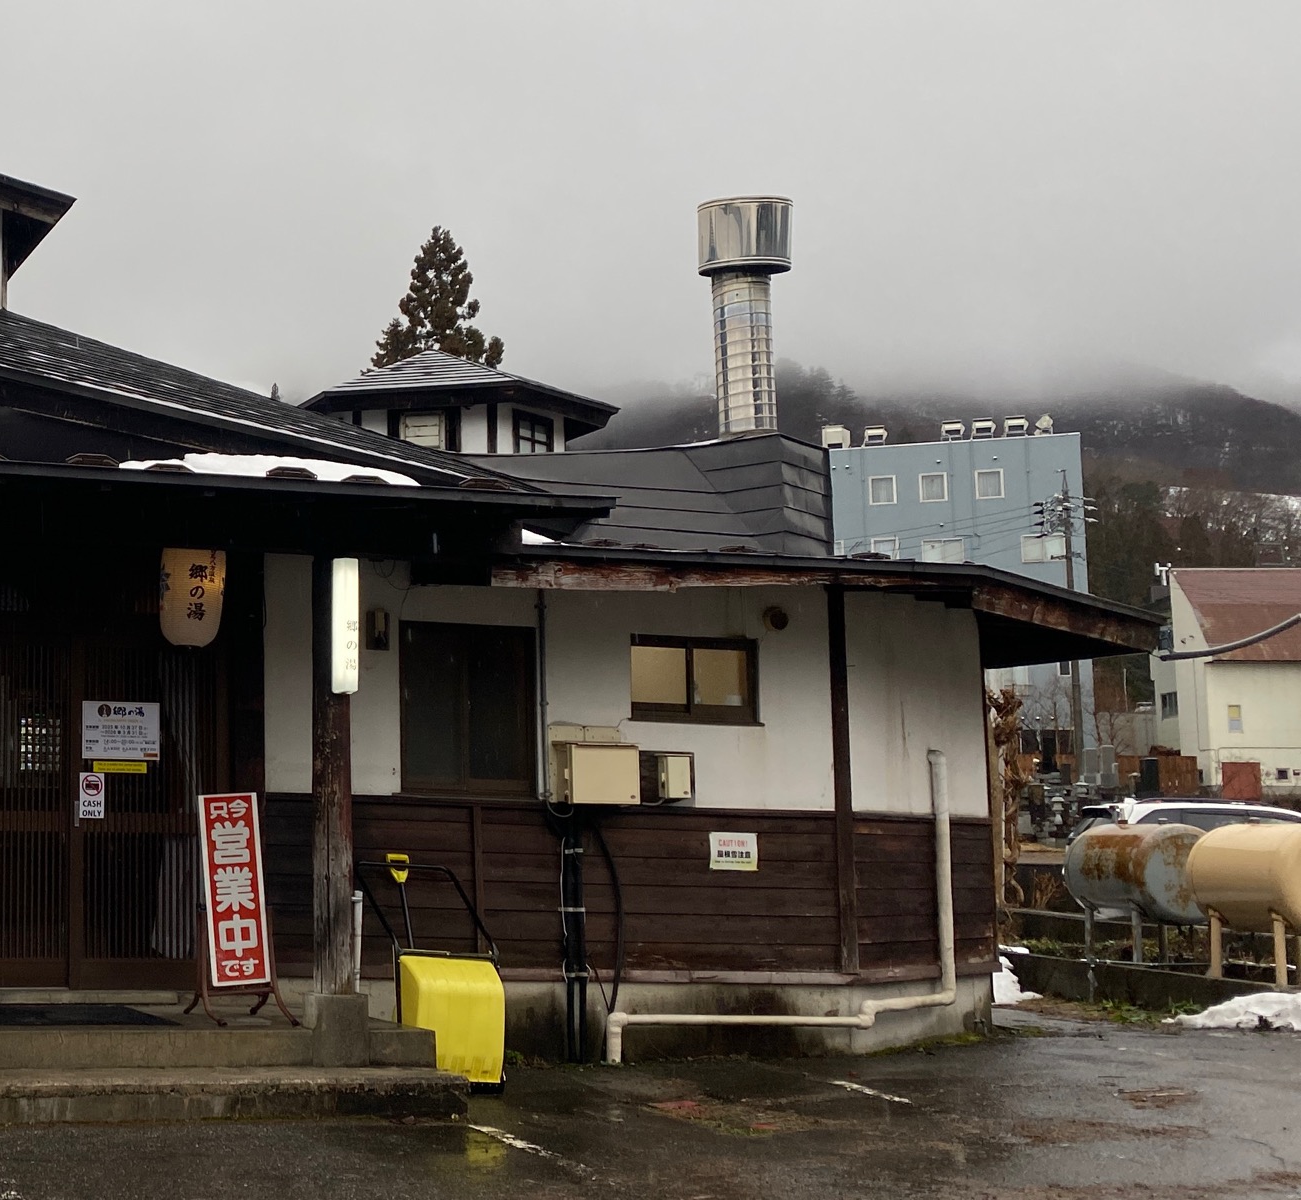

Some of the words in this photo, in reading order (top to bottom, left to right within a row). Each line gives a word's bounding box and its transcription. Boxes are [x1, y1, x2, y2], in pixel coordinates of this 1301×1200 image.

[187, 563, 208, 621] 郷の湯
[345, 619, 358, 671] 郷の湯
[82, 800, 102, 808] CASH
[210, 799, 249, 819] 只今
[211, 820, 259, 958] 営業中
[221, 957, 260, 978] です
